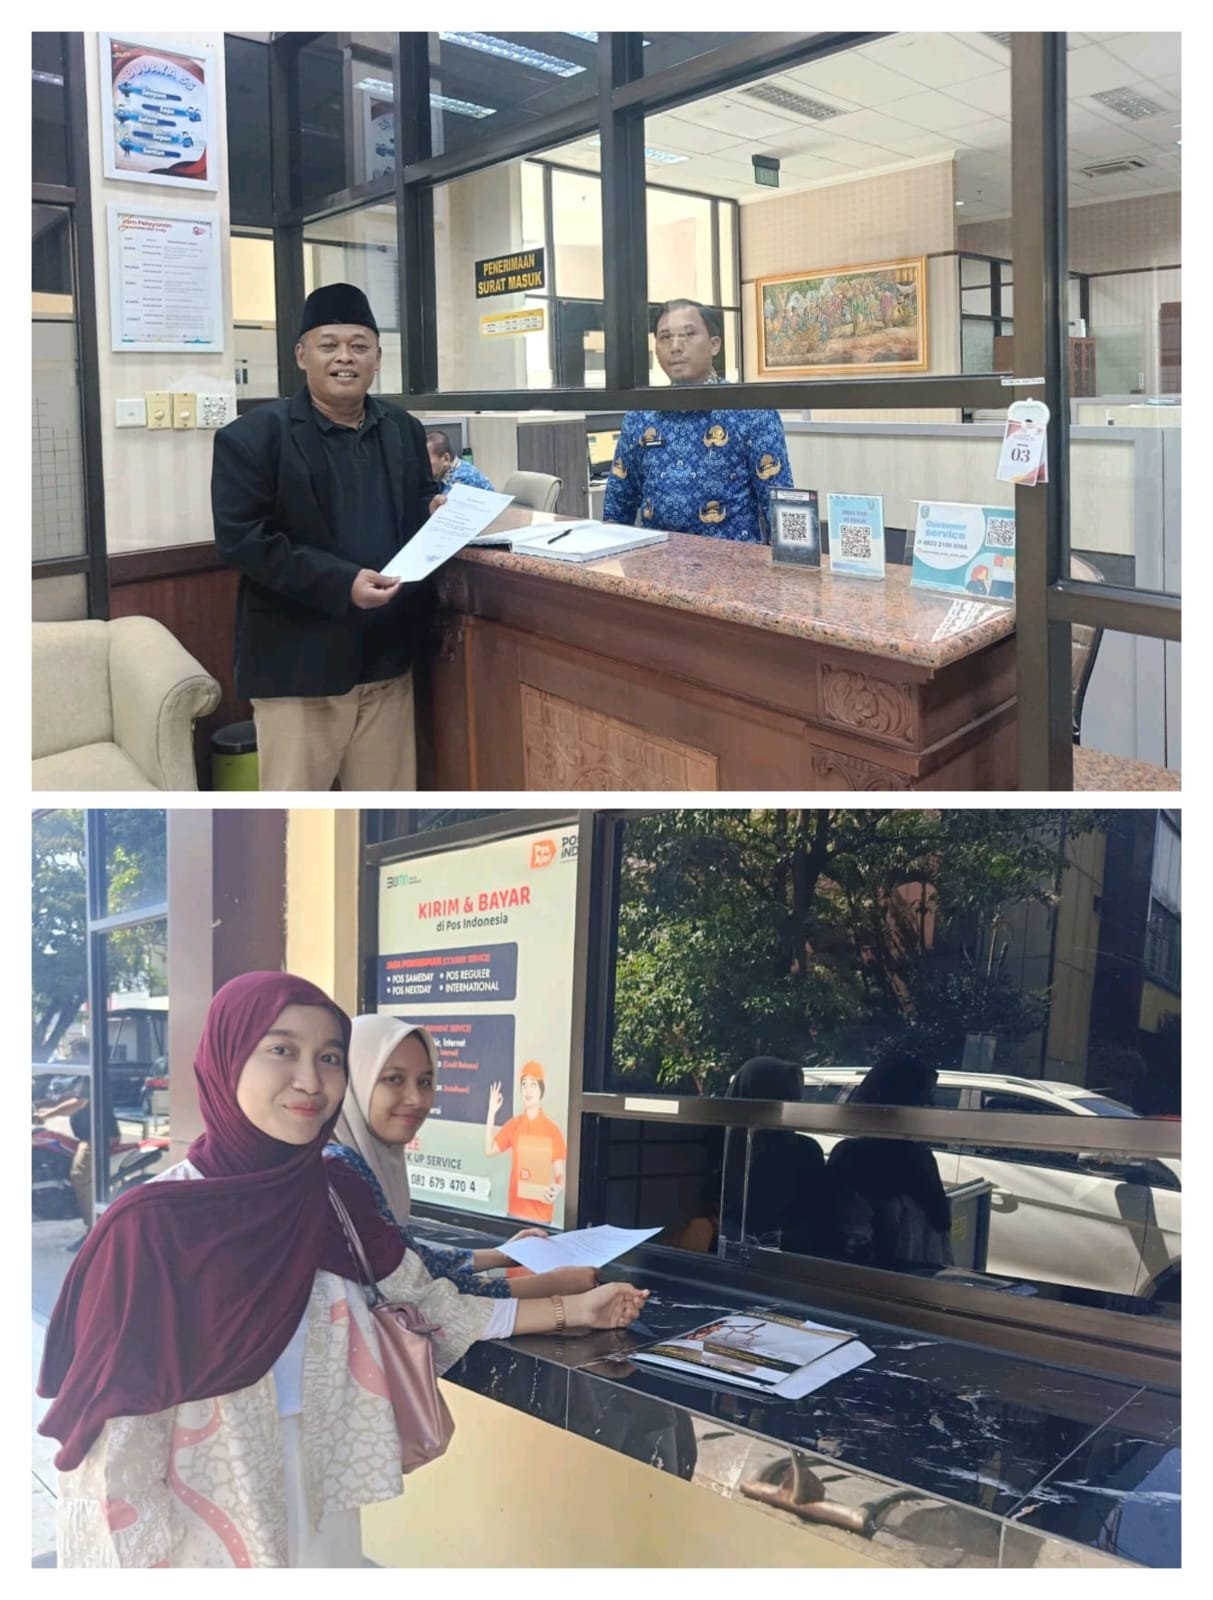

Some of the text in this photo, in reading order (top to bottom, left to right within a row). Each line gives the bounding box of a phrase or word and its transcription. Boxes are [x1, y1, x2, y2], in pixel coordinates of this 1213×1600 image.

[483, 253, 535, 277] PENERIMAAN
[478, 271, 542, 295] SURAT MASUK
[1011, 447, 1031, 463] 03
[925, 529, 966, 540] service
[418, 886, 531, 920] KIRIM & BAYAR
[436, 913, 508, 932] di Pos Indonesia
[392, 972, 434, 984] POS SAMEDAY
[446, 968, 490, 980] POS REGULER
[392, 985, 432, 996] POS NEXTDAY
[445, 981, 499, 993] INTERNATIONAL
[414, 1153, 425, 1164] UP
[427, 1155, 462, 1170] SERVICE
[411, 1174, 476, 1193] 081 679 470 4
